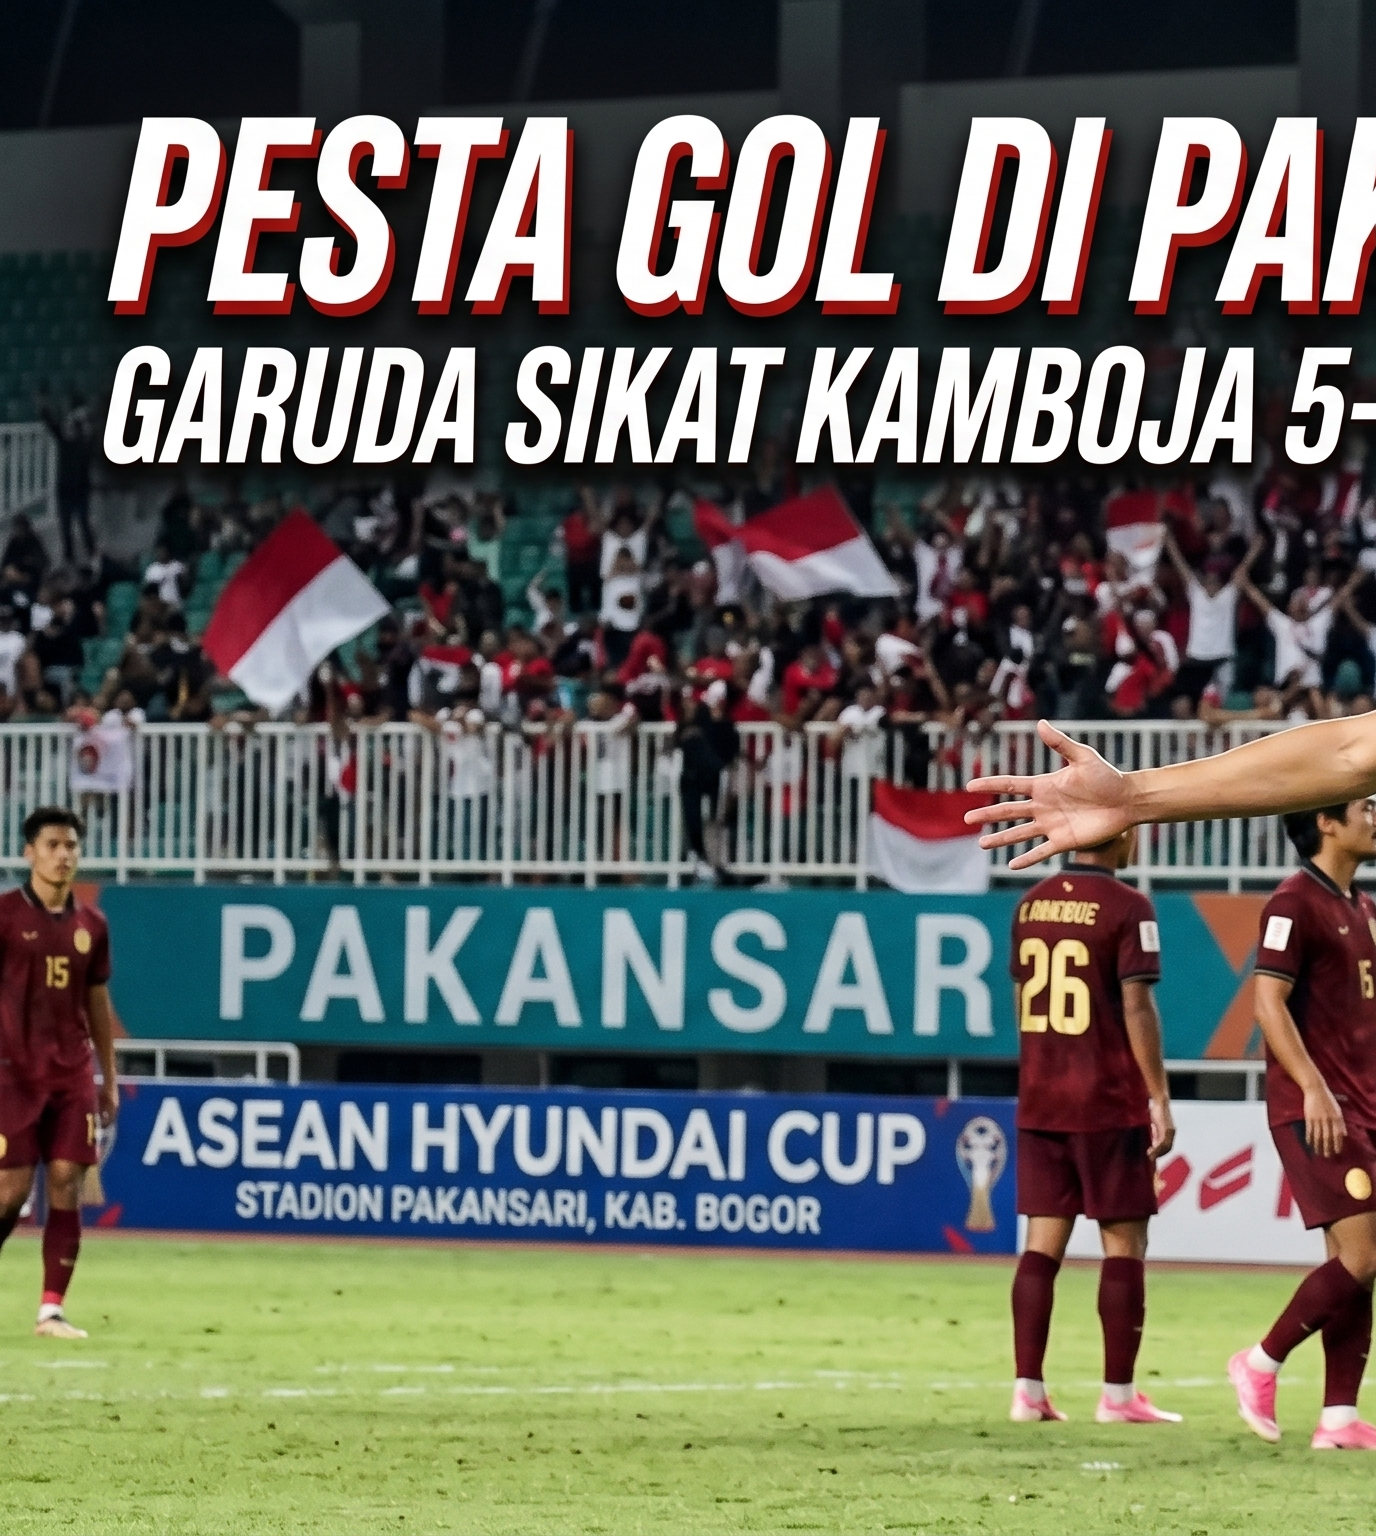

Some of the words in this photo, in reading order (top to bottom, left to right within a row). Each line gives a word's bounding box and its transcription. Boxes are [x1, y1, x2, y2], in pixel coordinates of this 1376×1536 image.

[45, 955, 71, 990] 15
[219, 904, 995, 1036] PAKANSAR
[1018, 937, 1091, 1036] 26
[143, 1096, 390, 1172] ASEAN
[411, 1101, 747, 1182] HYUNDAI
[767, 1110, 928, 1186] CUP
[235, 1180, 383, 1222] STADION
[391, 1184, 596, 1232] PAKANSARI,
[605, 1191, 686, 1231] KAB.
[696, 1194, 822, 1235] BOGOR
